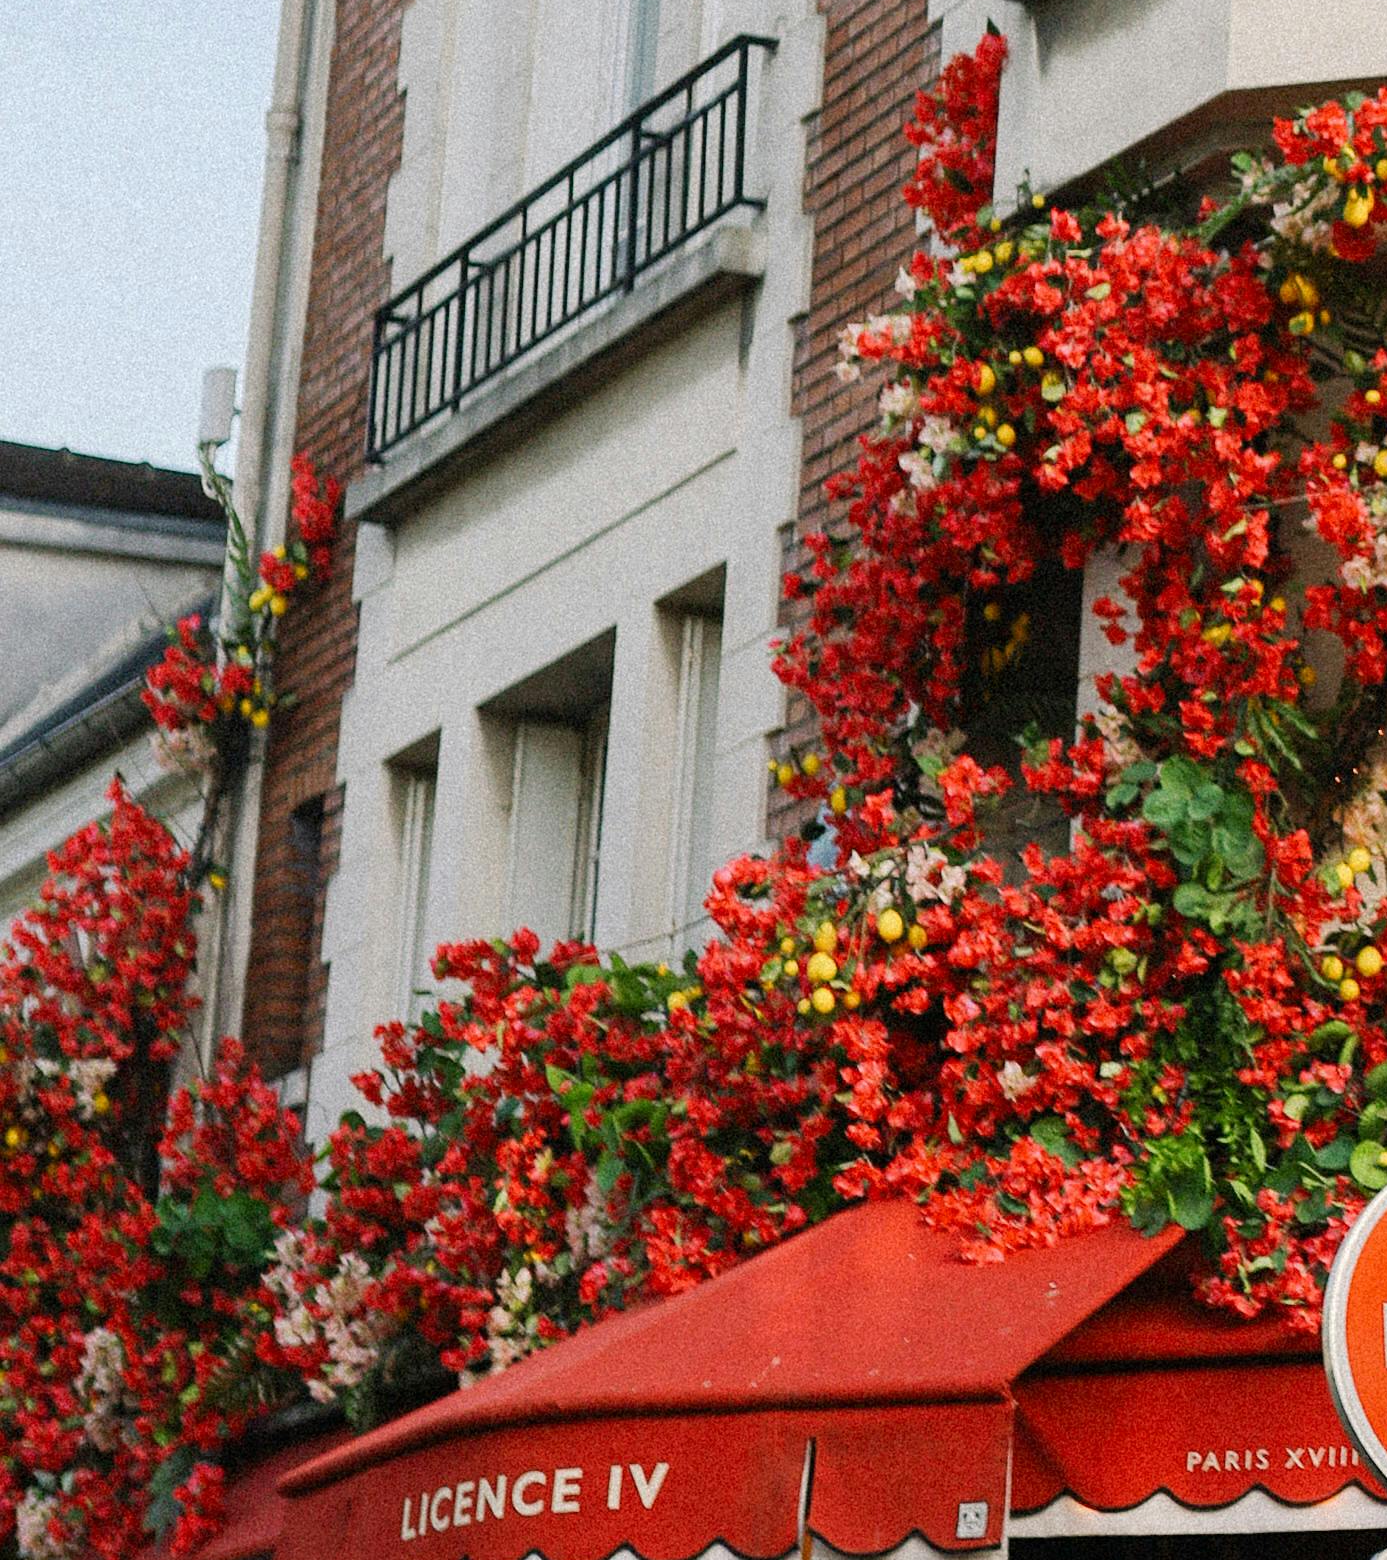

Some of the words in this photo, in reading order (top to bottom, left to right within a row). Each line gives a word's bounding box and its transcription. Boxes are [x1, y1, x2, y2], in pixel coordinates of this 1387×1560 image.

[1186, 1448, 1270, 1472] PARIS
[401, 1466, 584, 1541] LICENCE
[606, 1461, 671, 1511] IV
